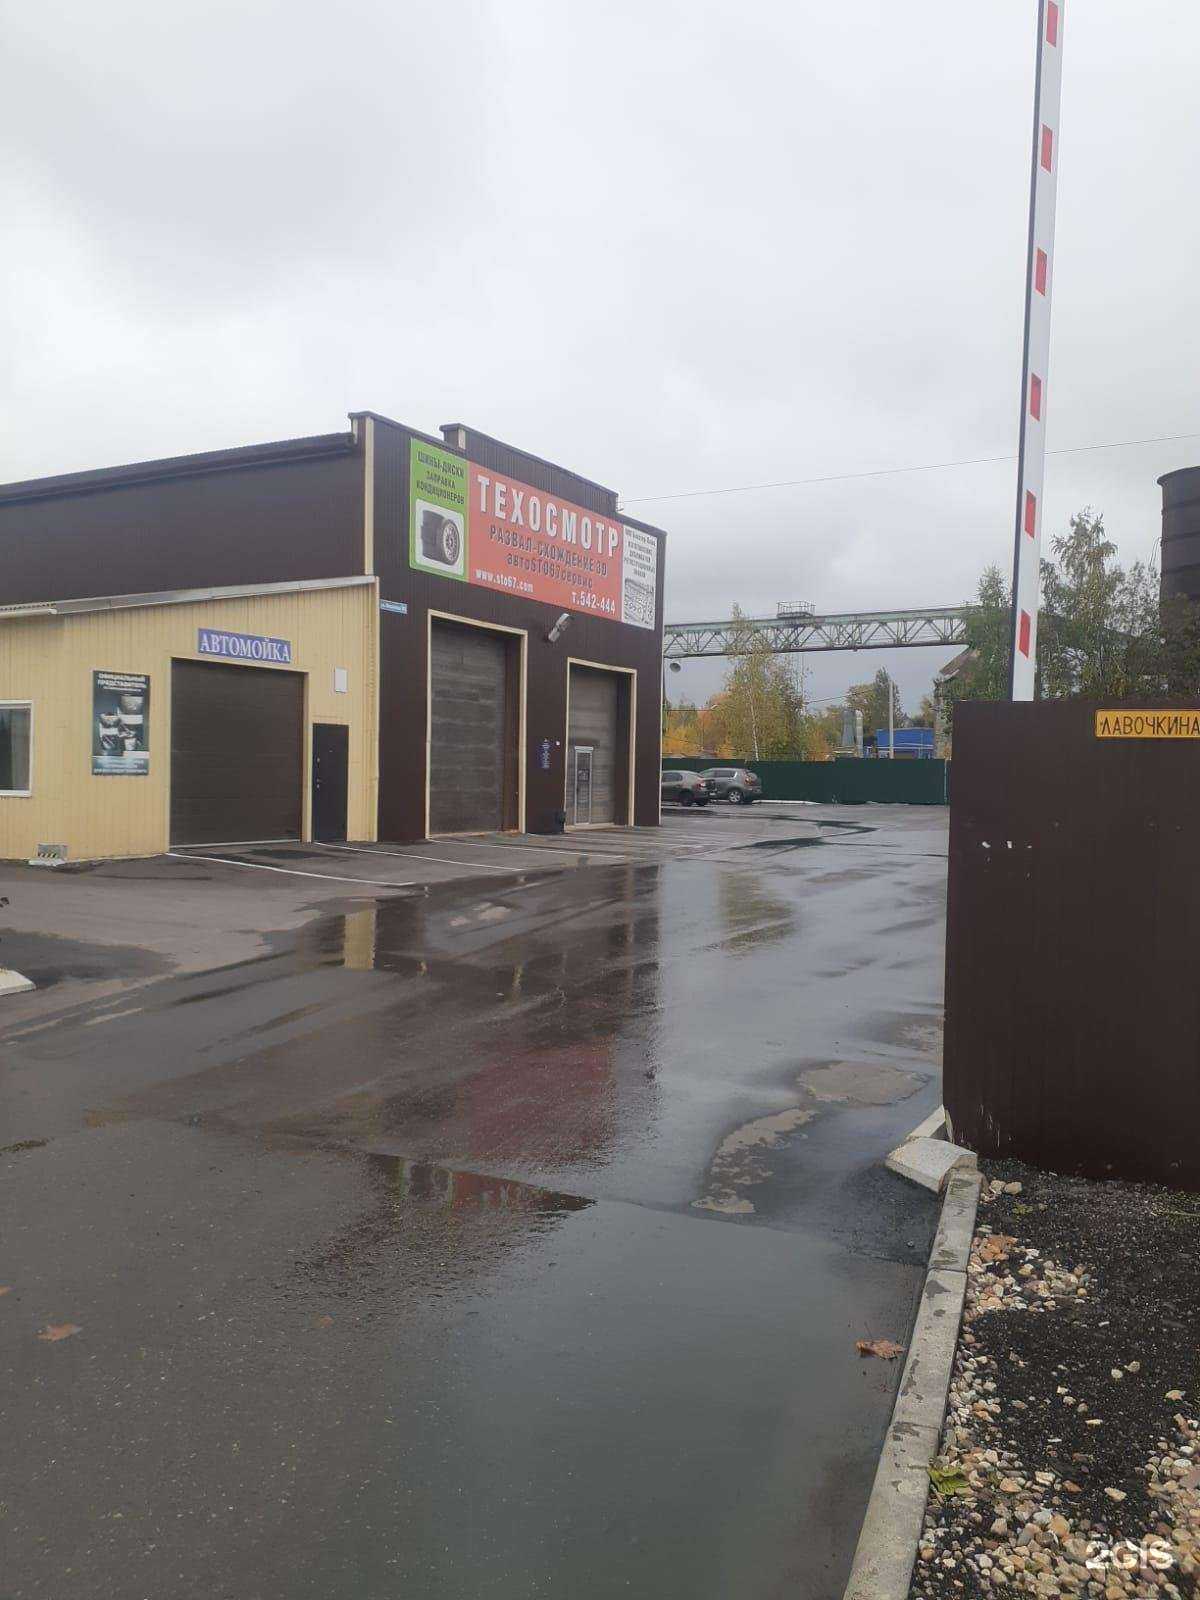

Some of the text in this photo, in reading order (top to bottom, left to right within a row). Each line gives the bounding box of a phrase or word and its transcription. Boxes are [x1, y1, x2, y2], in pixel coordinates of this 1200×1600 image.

[477, 474, 619, 557] ТЕХОСМОТР
[475, 569, 534, 593] www.sto67.com
[200, 632, 290, 661] АВТОМОЙКА
[1101, 716, 1200, 735] ЛАВОЧКИНА
